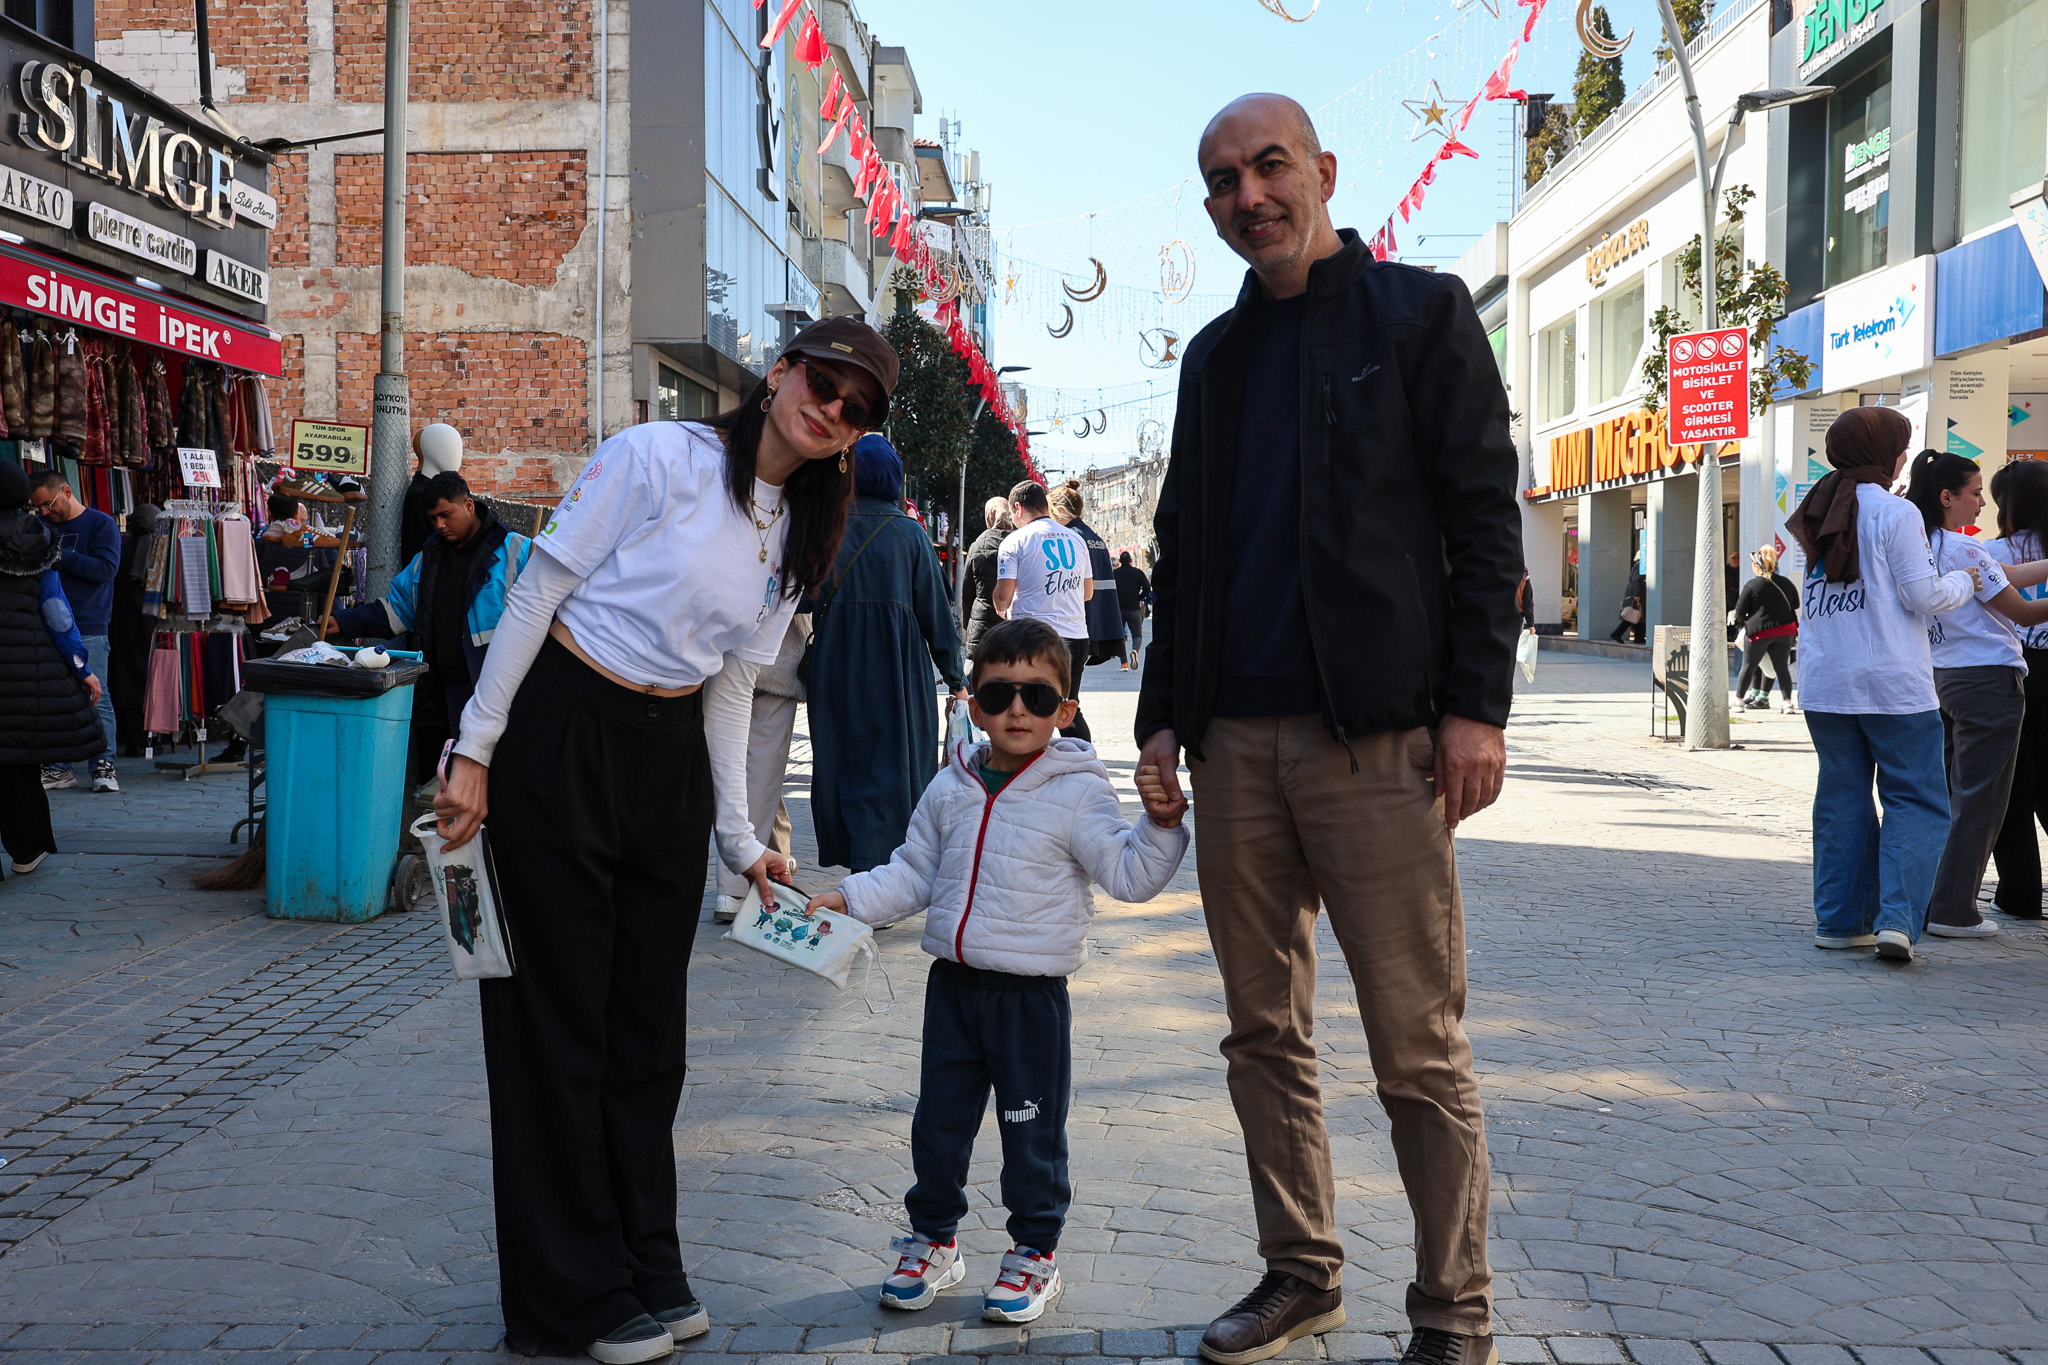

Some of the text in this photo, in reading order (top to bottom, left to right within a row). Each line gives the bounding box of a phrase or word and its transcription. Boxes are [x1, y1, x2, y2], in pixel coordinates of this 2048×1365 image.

[1850, 12, 1879, 45] İNŞAAT
[30, 61, 237, 230] SİMGE
[1845, 126, 1890, 173] DENGE
[252, 201, 275, 221] Home
[92, 208, 194, 269] pierre cardin
[213, 257, 263, 299] AKER
[26, 270, 137, 335] SİMGE
[1852, 317, 1896, 343] Telekom
[1672, 360, 1744, 378] MOTOSİKLET
[1682, 374, 1734, 390] BİSİKLET
[1699, 389, 1715, 400] VE
[1682, 400, 1734, 414] SCOOTER
[1684, 411, 1732, 427] GİRMESİ
[304, 432, 352, 442] AYAKKABILAR
[1680, 425, 1737, 440] YASAKTIR
[183, 452, 188, 460] 1
[184, 462, 189, 470] 1
[1551, 427, 1593, 493] MM
[1041, 537, 1076, 571] SU
[1044, 570, 1081, 596] Elçisi
[1805, 578, 1866, 620] Elçisi
[1004, 1107, 1036, 1123] PUMA
